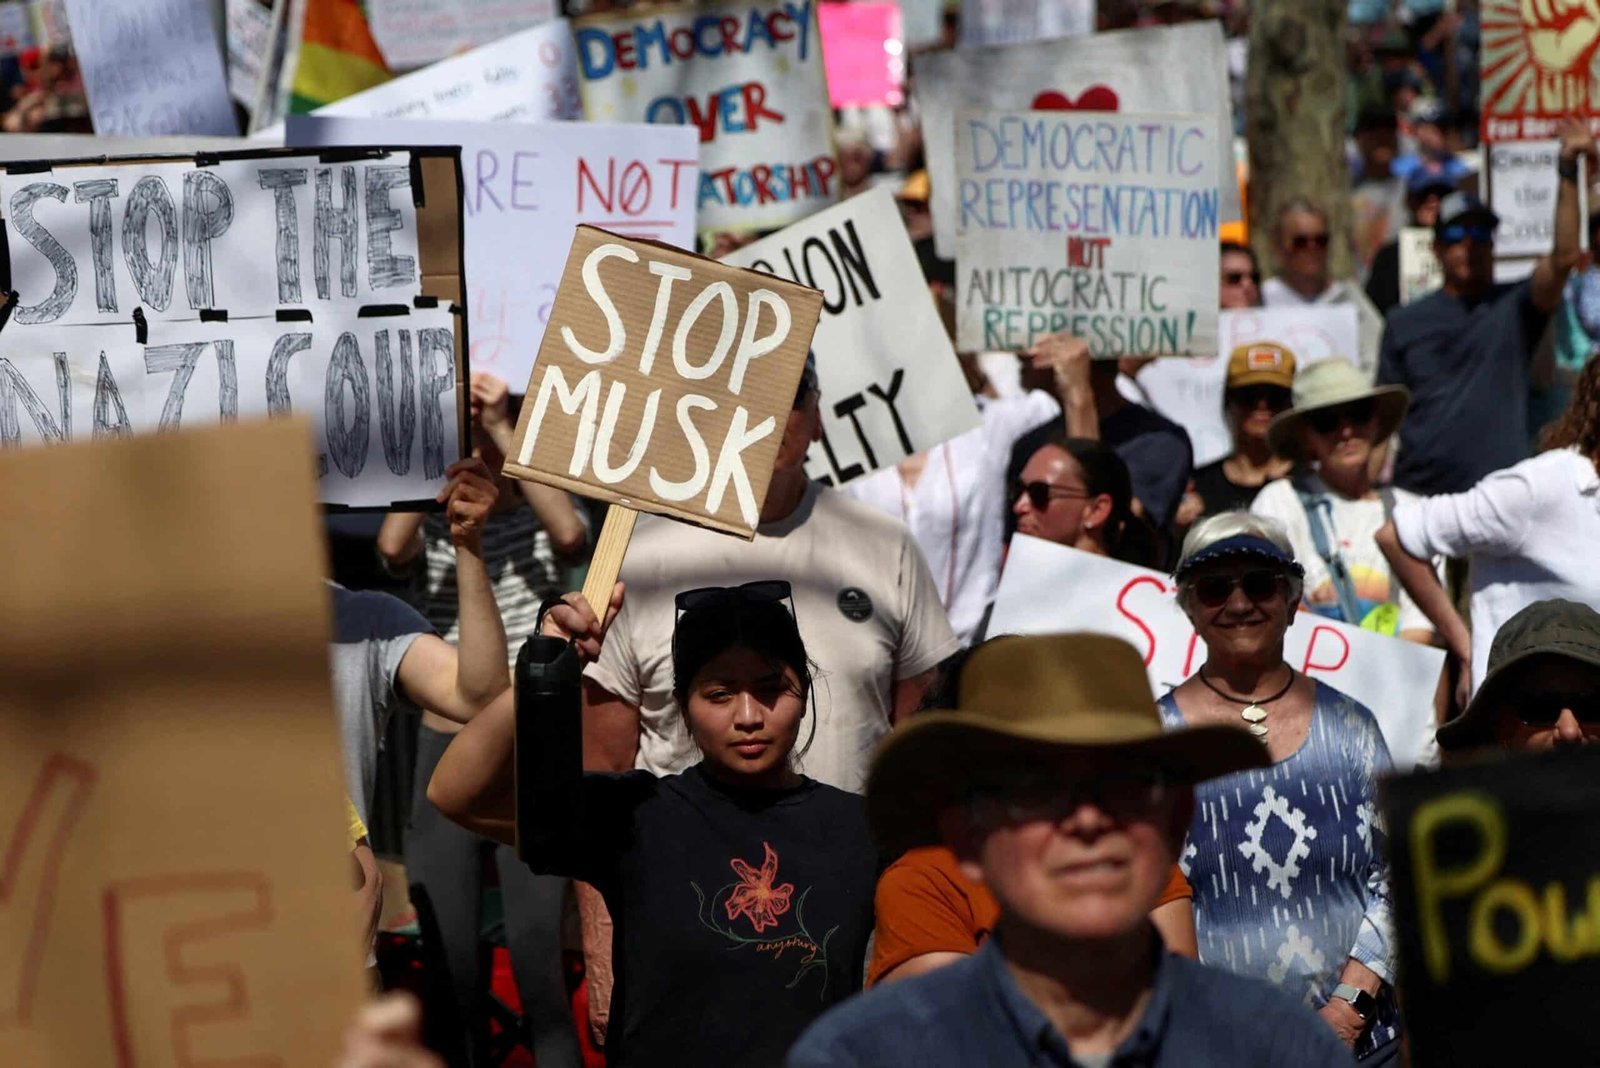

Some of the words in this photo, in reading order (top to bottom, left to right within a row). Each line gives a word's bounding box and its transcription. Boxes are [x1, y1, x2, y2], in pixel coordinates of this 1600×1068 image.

[575, 1, 813, 80] DEMOCRACY
[645, 81, 785, 143] OVER
[968, 116, 1204, 177] DEMOCRATIC
[10, 169, 235, 325] STOP
[257, 165, 416, 304] THE
[959, 179, 1218, 240] REPRESENTATION
[966, 267, 1168, 312] AUTOCRATIC
[1067, 236, 1112, 270] NOT
[561, 243, 792, 395] STOP
[265, 328, 455, 480] COUP
[517, 365, 776, 530] MUSK
[1116, 575, 1350, 678] SP
